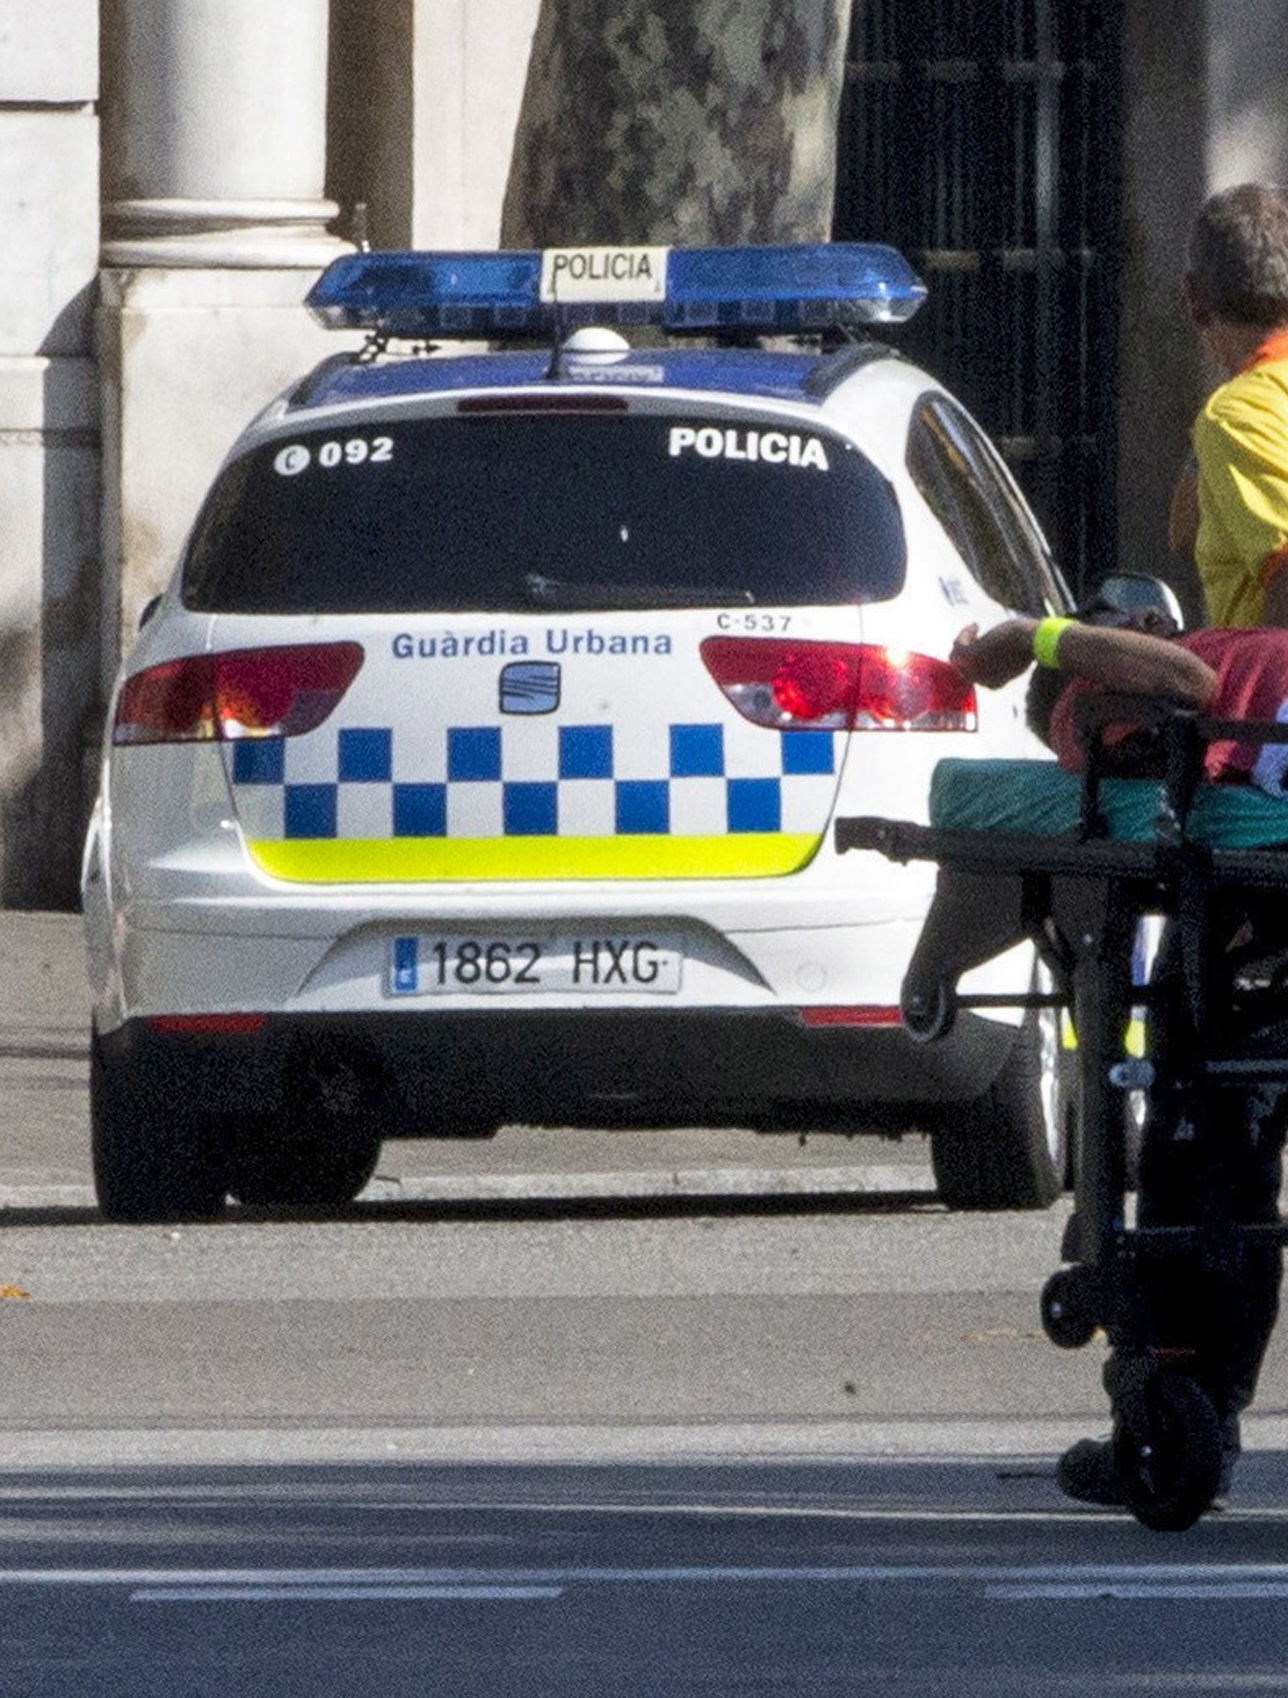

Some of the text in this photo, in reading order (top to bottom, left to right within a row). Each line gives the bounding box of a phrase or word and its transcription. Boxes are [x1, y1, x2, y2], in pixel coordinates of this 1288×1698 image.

[553, 253, 653, 280] POLICIA
[318, 436, 394, 468] 092
[668, 426, 830, 472] POLICIA
[716, 612, 792, 632] C-537
[391, 629, 673, 659] Guàrdia Urbana
[433, 940, 541, 985] 1862
[572, 940, 659, 985] HXG
